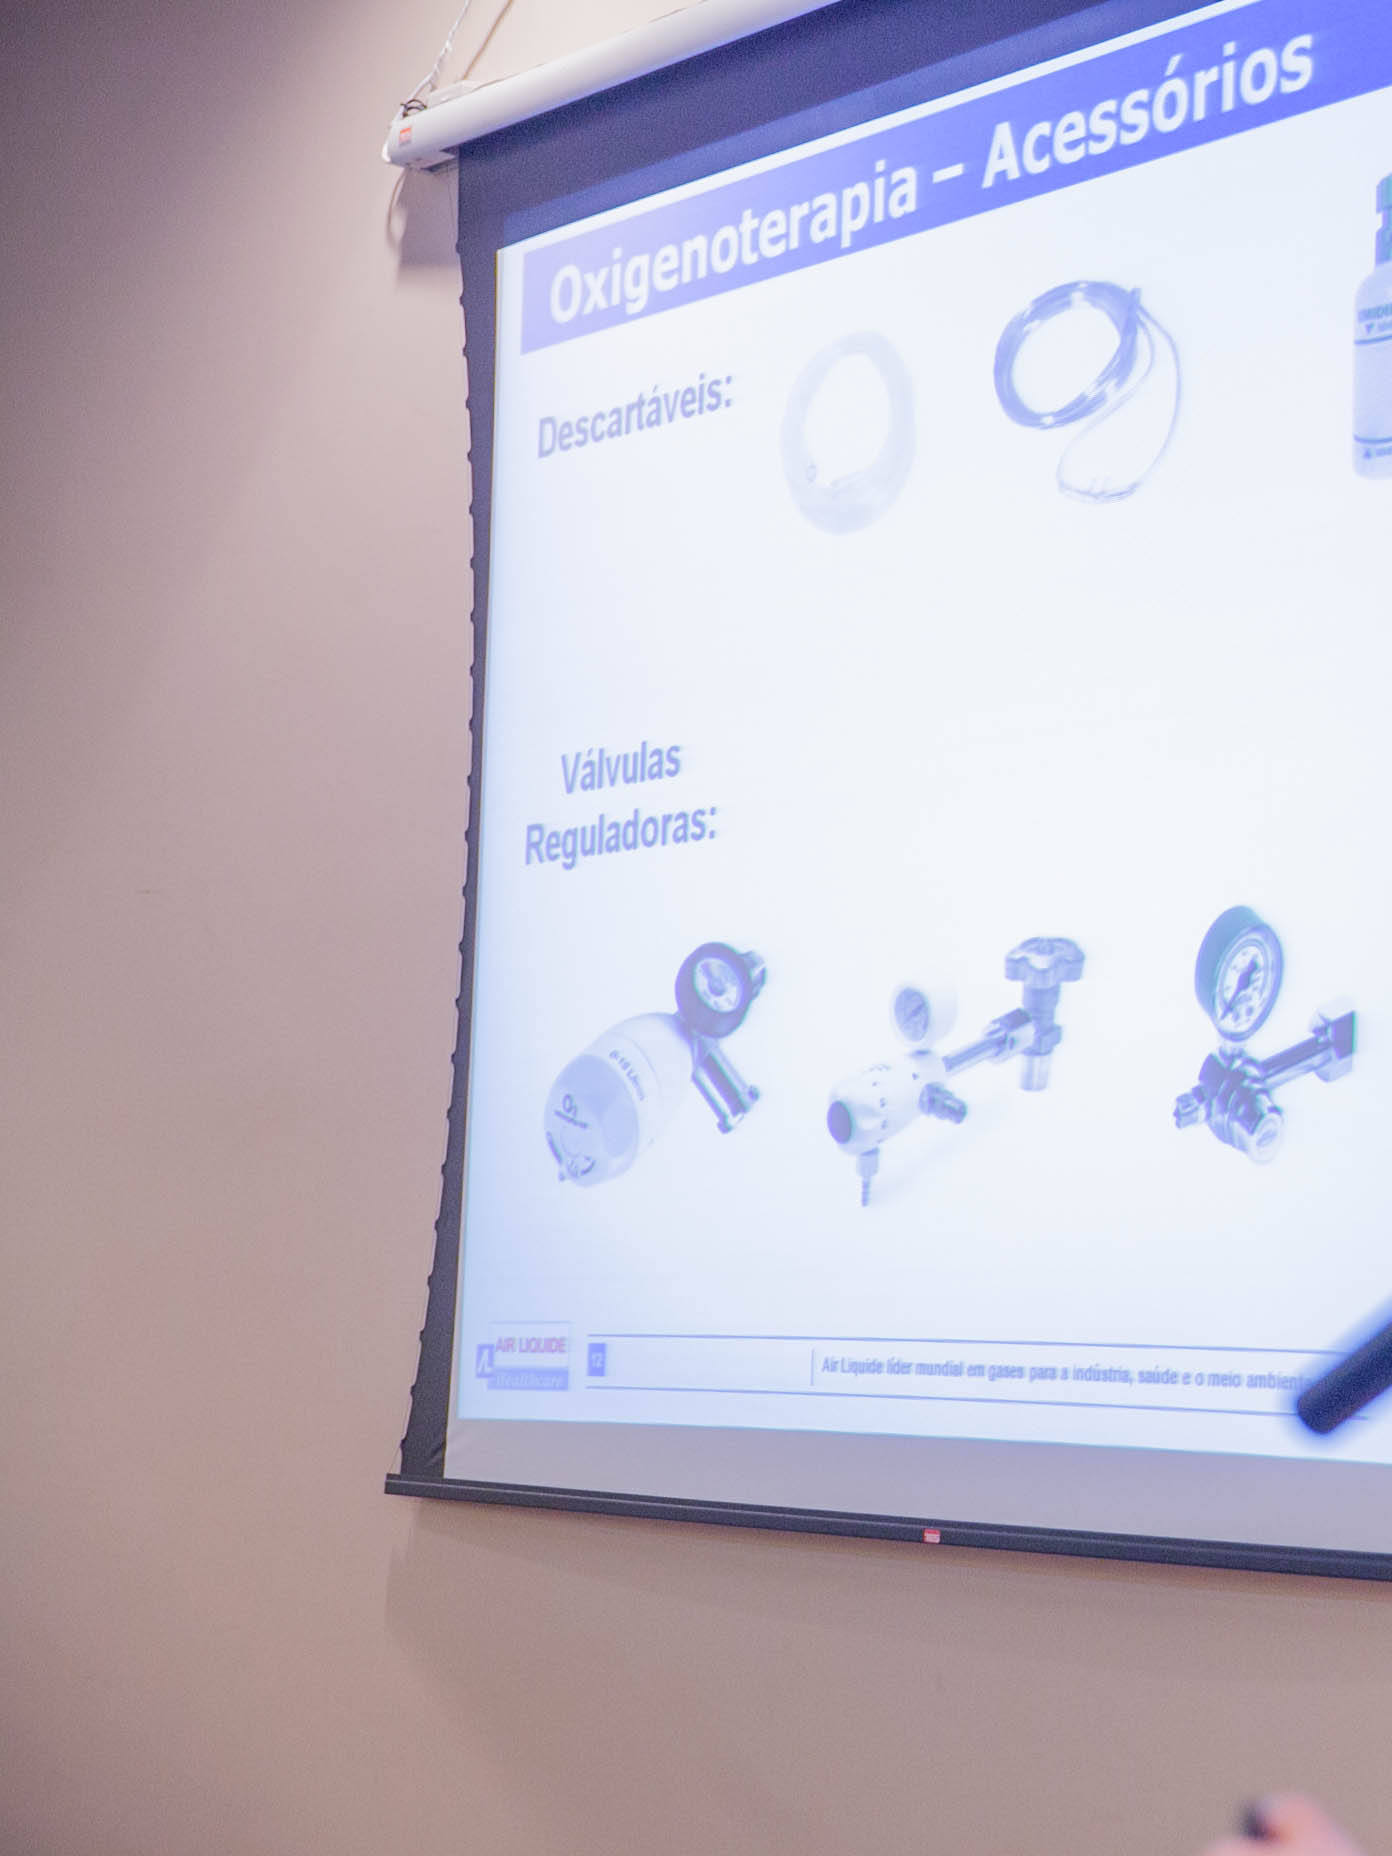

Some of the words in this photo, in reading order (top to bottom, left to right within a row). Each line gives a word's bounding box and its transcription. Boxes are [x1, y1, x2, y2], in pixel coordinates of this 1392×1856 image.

[549, 160, 917, 323] Oxigenoterapia
[982, 34, 1315, 188] Acessórios
[538, 372, 732, 458] Descartáveis:
[561, 741, 682, 794] Válvulas
[525, 806, 717, 870] Reguladoras:
[496, 1337, 515, 1353] AIR
[519, 1336, 566, 1353] LIQUIDE
[821, 1356, 838, 1373] Air
[840, 1357, 883, 1376] Liquide
[886, 1356, 912, 1375] líder
[915, 1360, 964, 1377] mundial
[967, 1363, 985, 1378] em
[988, 1364, 1025, 1382] gases
[1029, 1366, 1057, 1382] para
[1060, 1367, 1069, 1381] a
[1072, 1363, 1134, 1387] indústria,
[1138, 1365, 1178, 1386] saúde
[1182, 1372, 1191, 1386] e
[1195, 1372, 1204, 1387] o
[1207, 1370, 1241, 1388] meio
